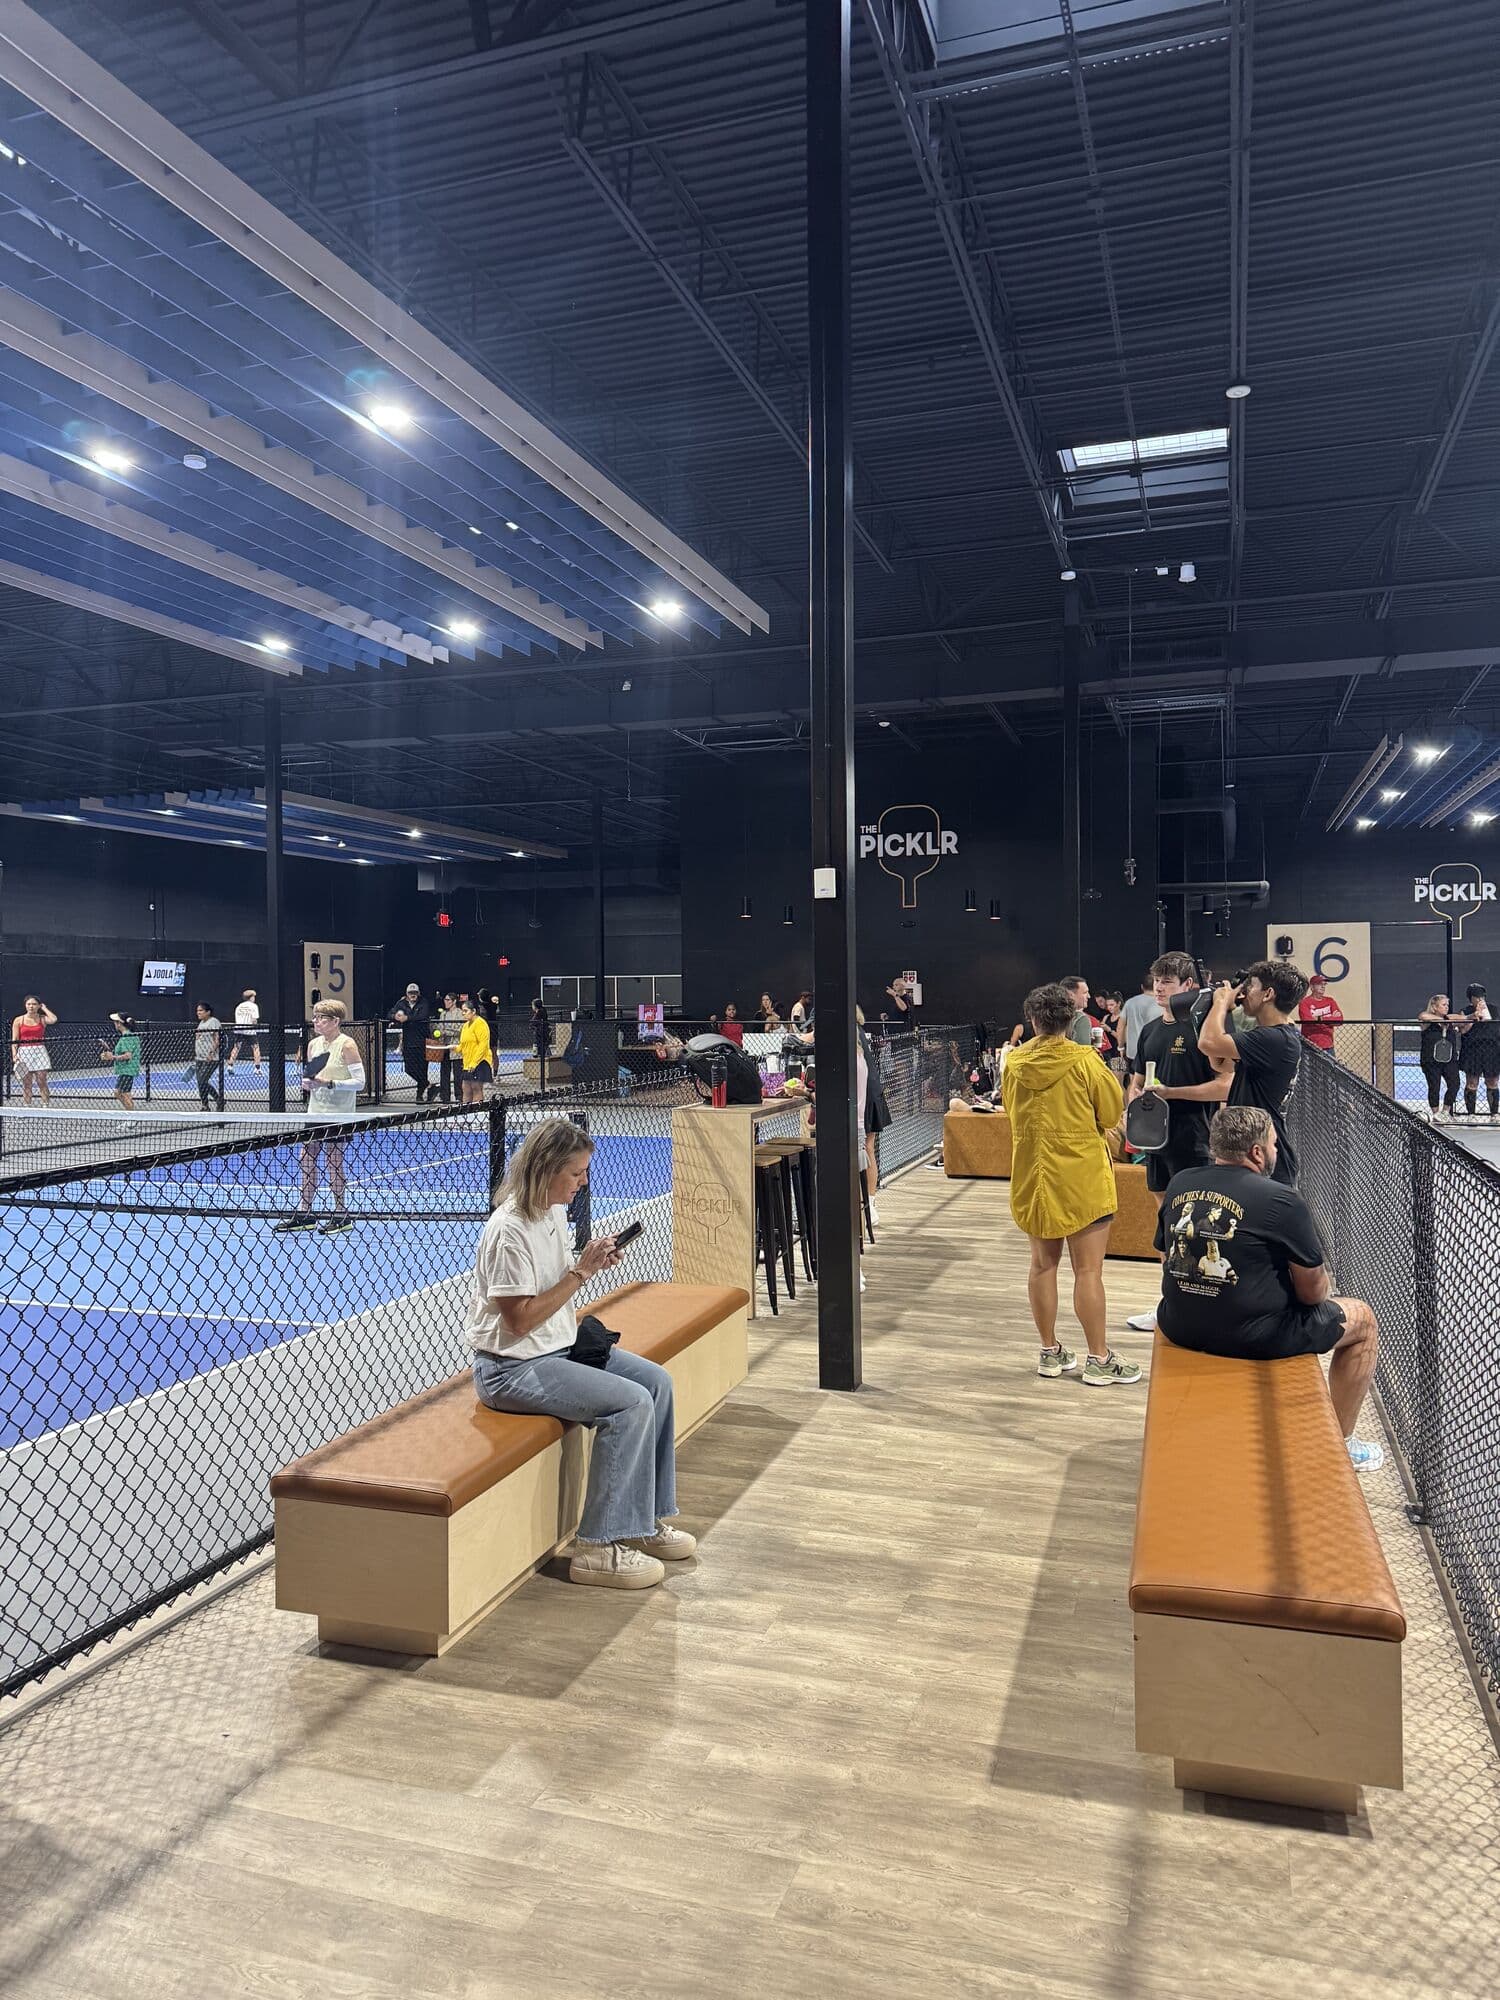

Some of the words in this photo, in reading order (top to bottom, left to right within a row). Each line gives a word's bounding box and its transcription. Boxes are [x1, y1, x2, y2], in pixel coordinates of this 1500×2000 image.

[860, 824, 878, 834] THE
[859, 830, 959, 859] PICKLR
[1414, 876, 1430, 886] THE
[1414, 881, 1497, 904] PICKLR
[1313, 936, 1351, 983] 6
[153, 968, 173, 979] JOOLA
[327, 954, 346, 993] 5
[680, 1196, 744, 1216] PICKLR
[1171, 1191, 1199, 1210] COACHES
[1206, 1191, 1245, 1221] SUPPORTERS
